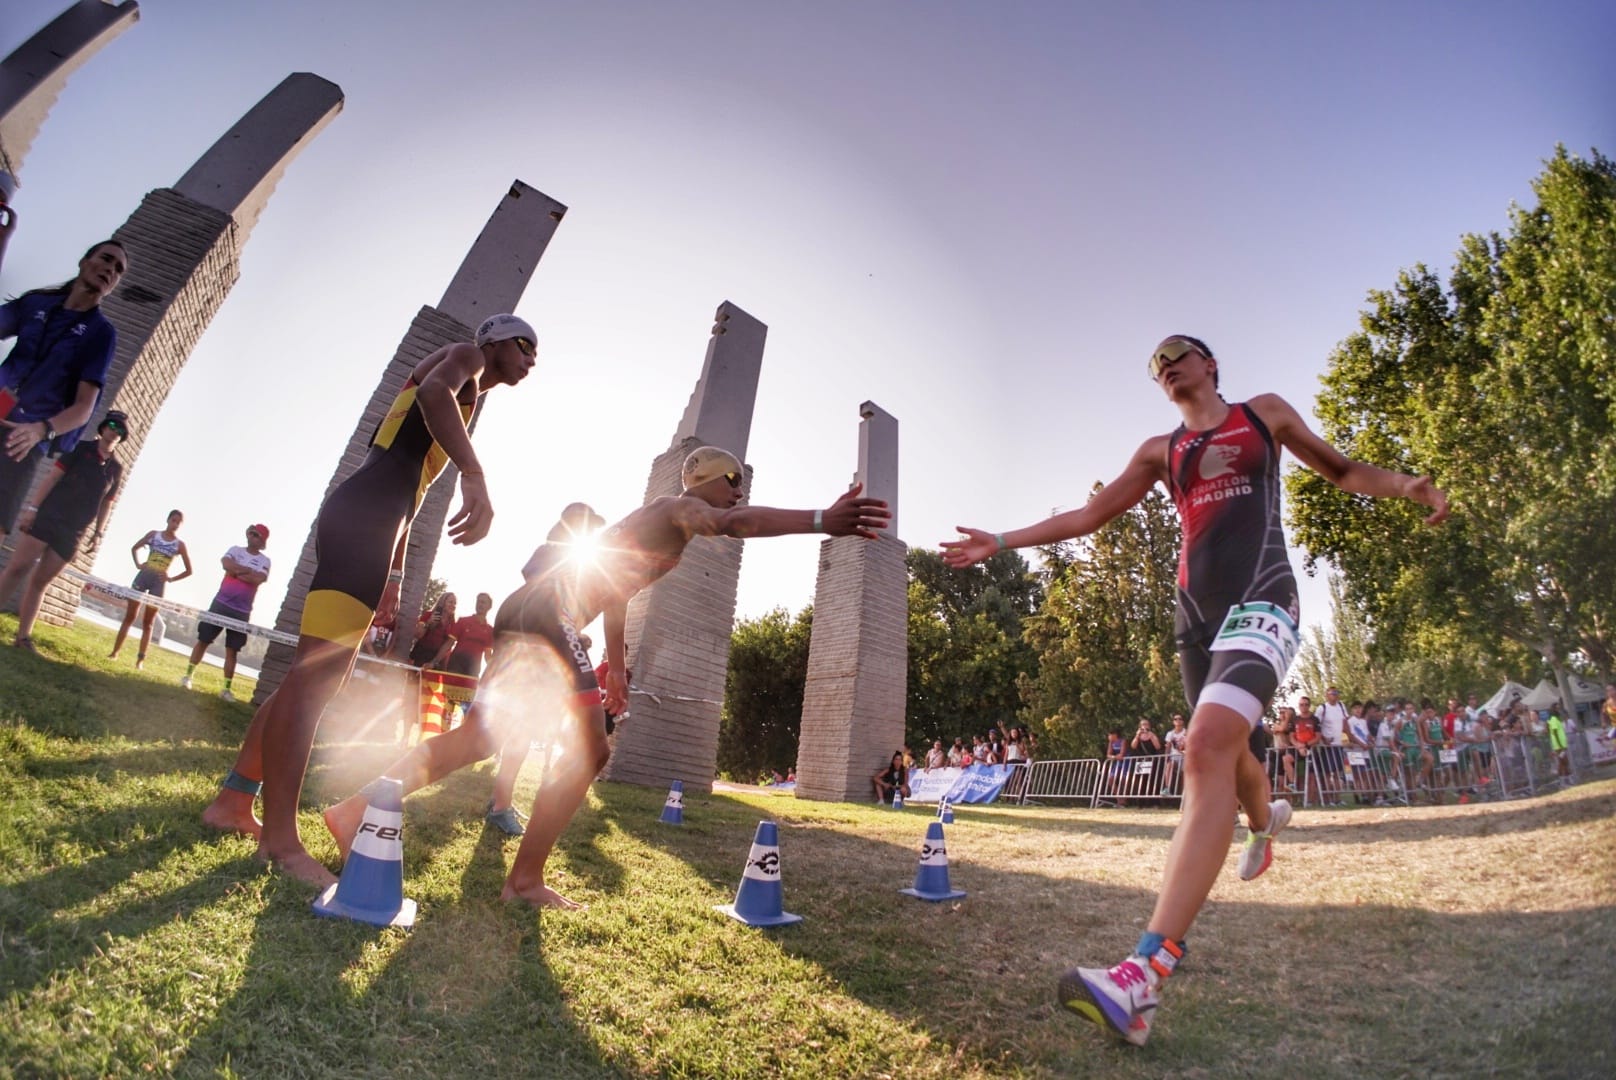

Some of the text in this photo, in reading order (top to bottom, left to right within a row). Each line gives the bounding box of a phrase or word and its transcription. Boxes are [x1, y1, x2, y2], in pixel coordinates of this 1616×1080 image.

[1192, 475, 1250, 495] TRIATLON
[1192, 485, 1253, 507] MADRID
[1226, 616, 1279, 639] 451A
